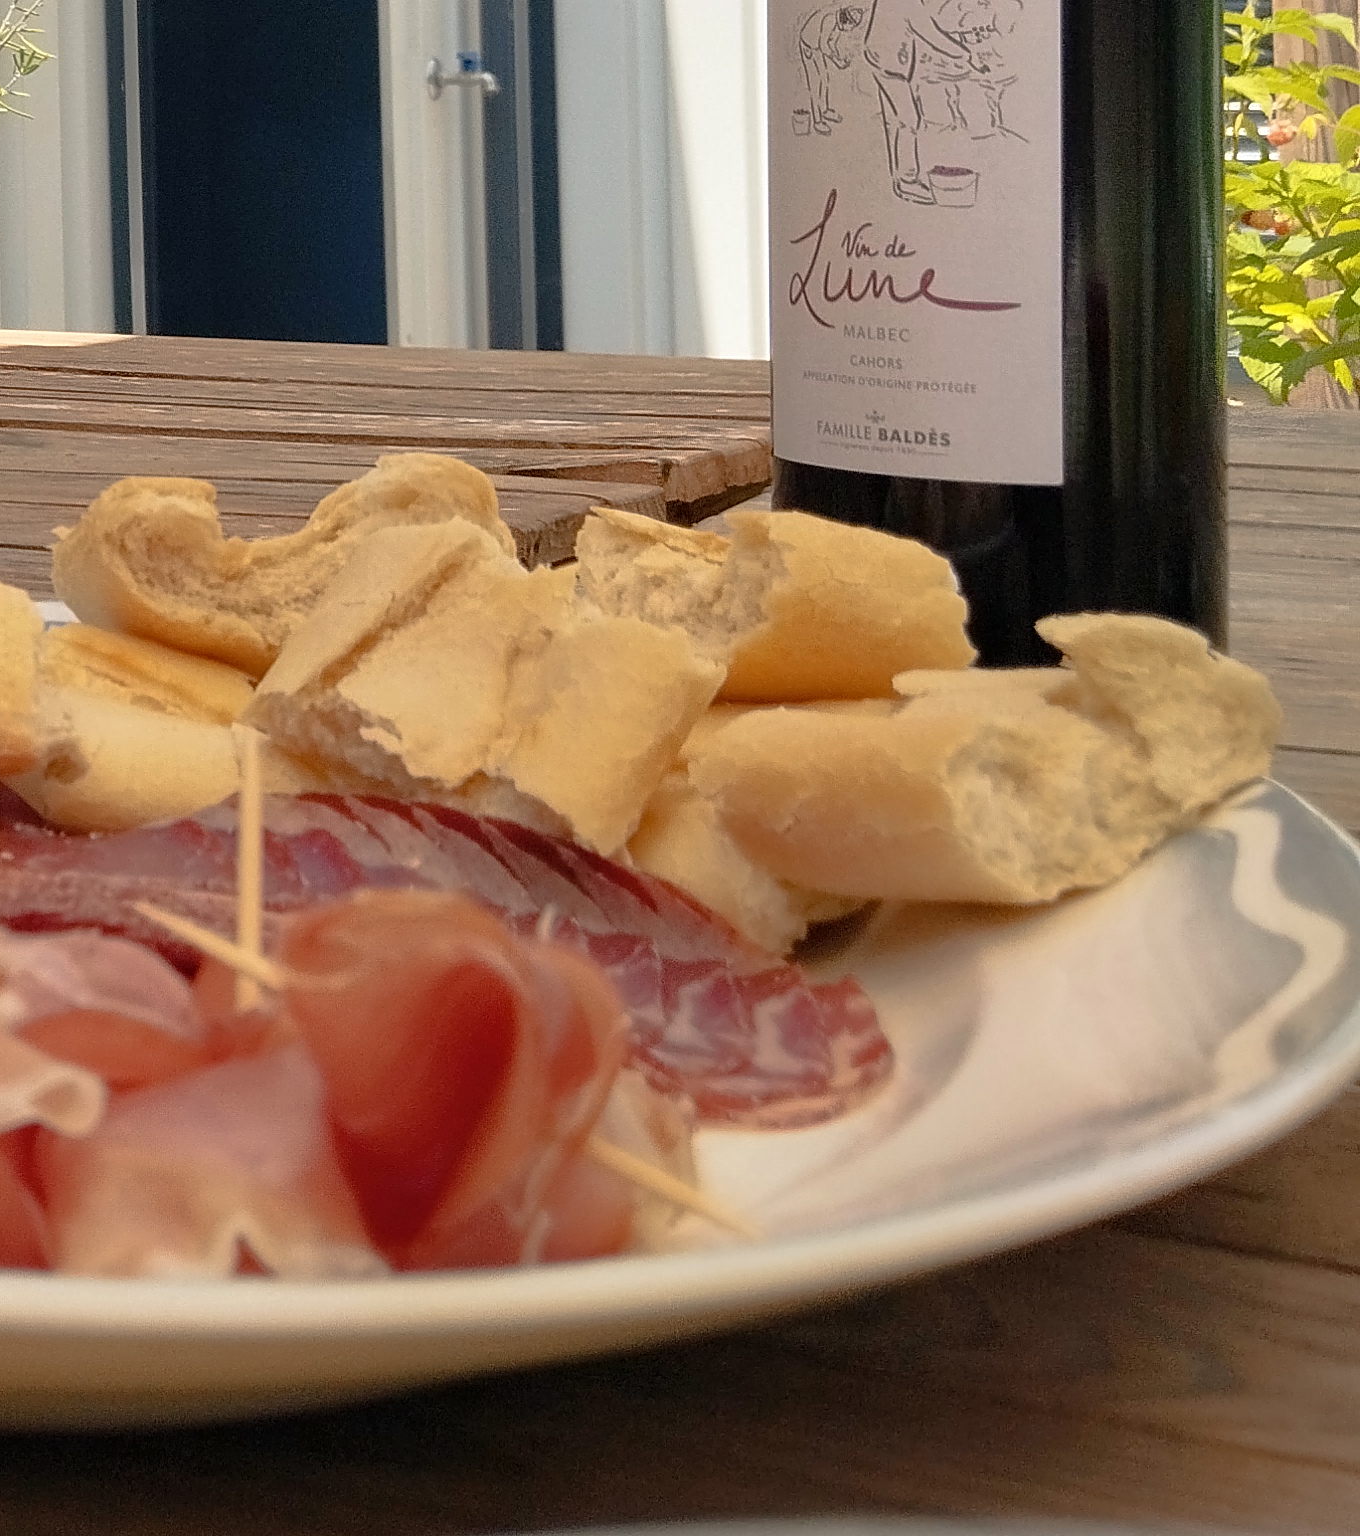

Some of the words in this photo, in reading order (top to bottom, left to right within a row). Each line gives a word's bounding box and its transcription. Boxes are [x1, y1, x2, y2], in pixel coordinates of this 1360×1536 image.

[842, 222, 879, 258] Vin
[884, 234, 916, 258] de
[790, 188, 1021, 328] Lune
[843, 324, 910, 343] MALBEC
[849, 354, 903, 370] CAHORS
[802, 369, 856, 385] APPELLATION
[858, 376, 912, 391] D'ORIGINE
[916, 380, 978, 395] PROTÉGÉE
[816, 420, 872, 441] FAMILLE
[877, 427, 951, 447] BALDÈS
